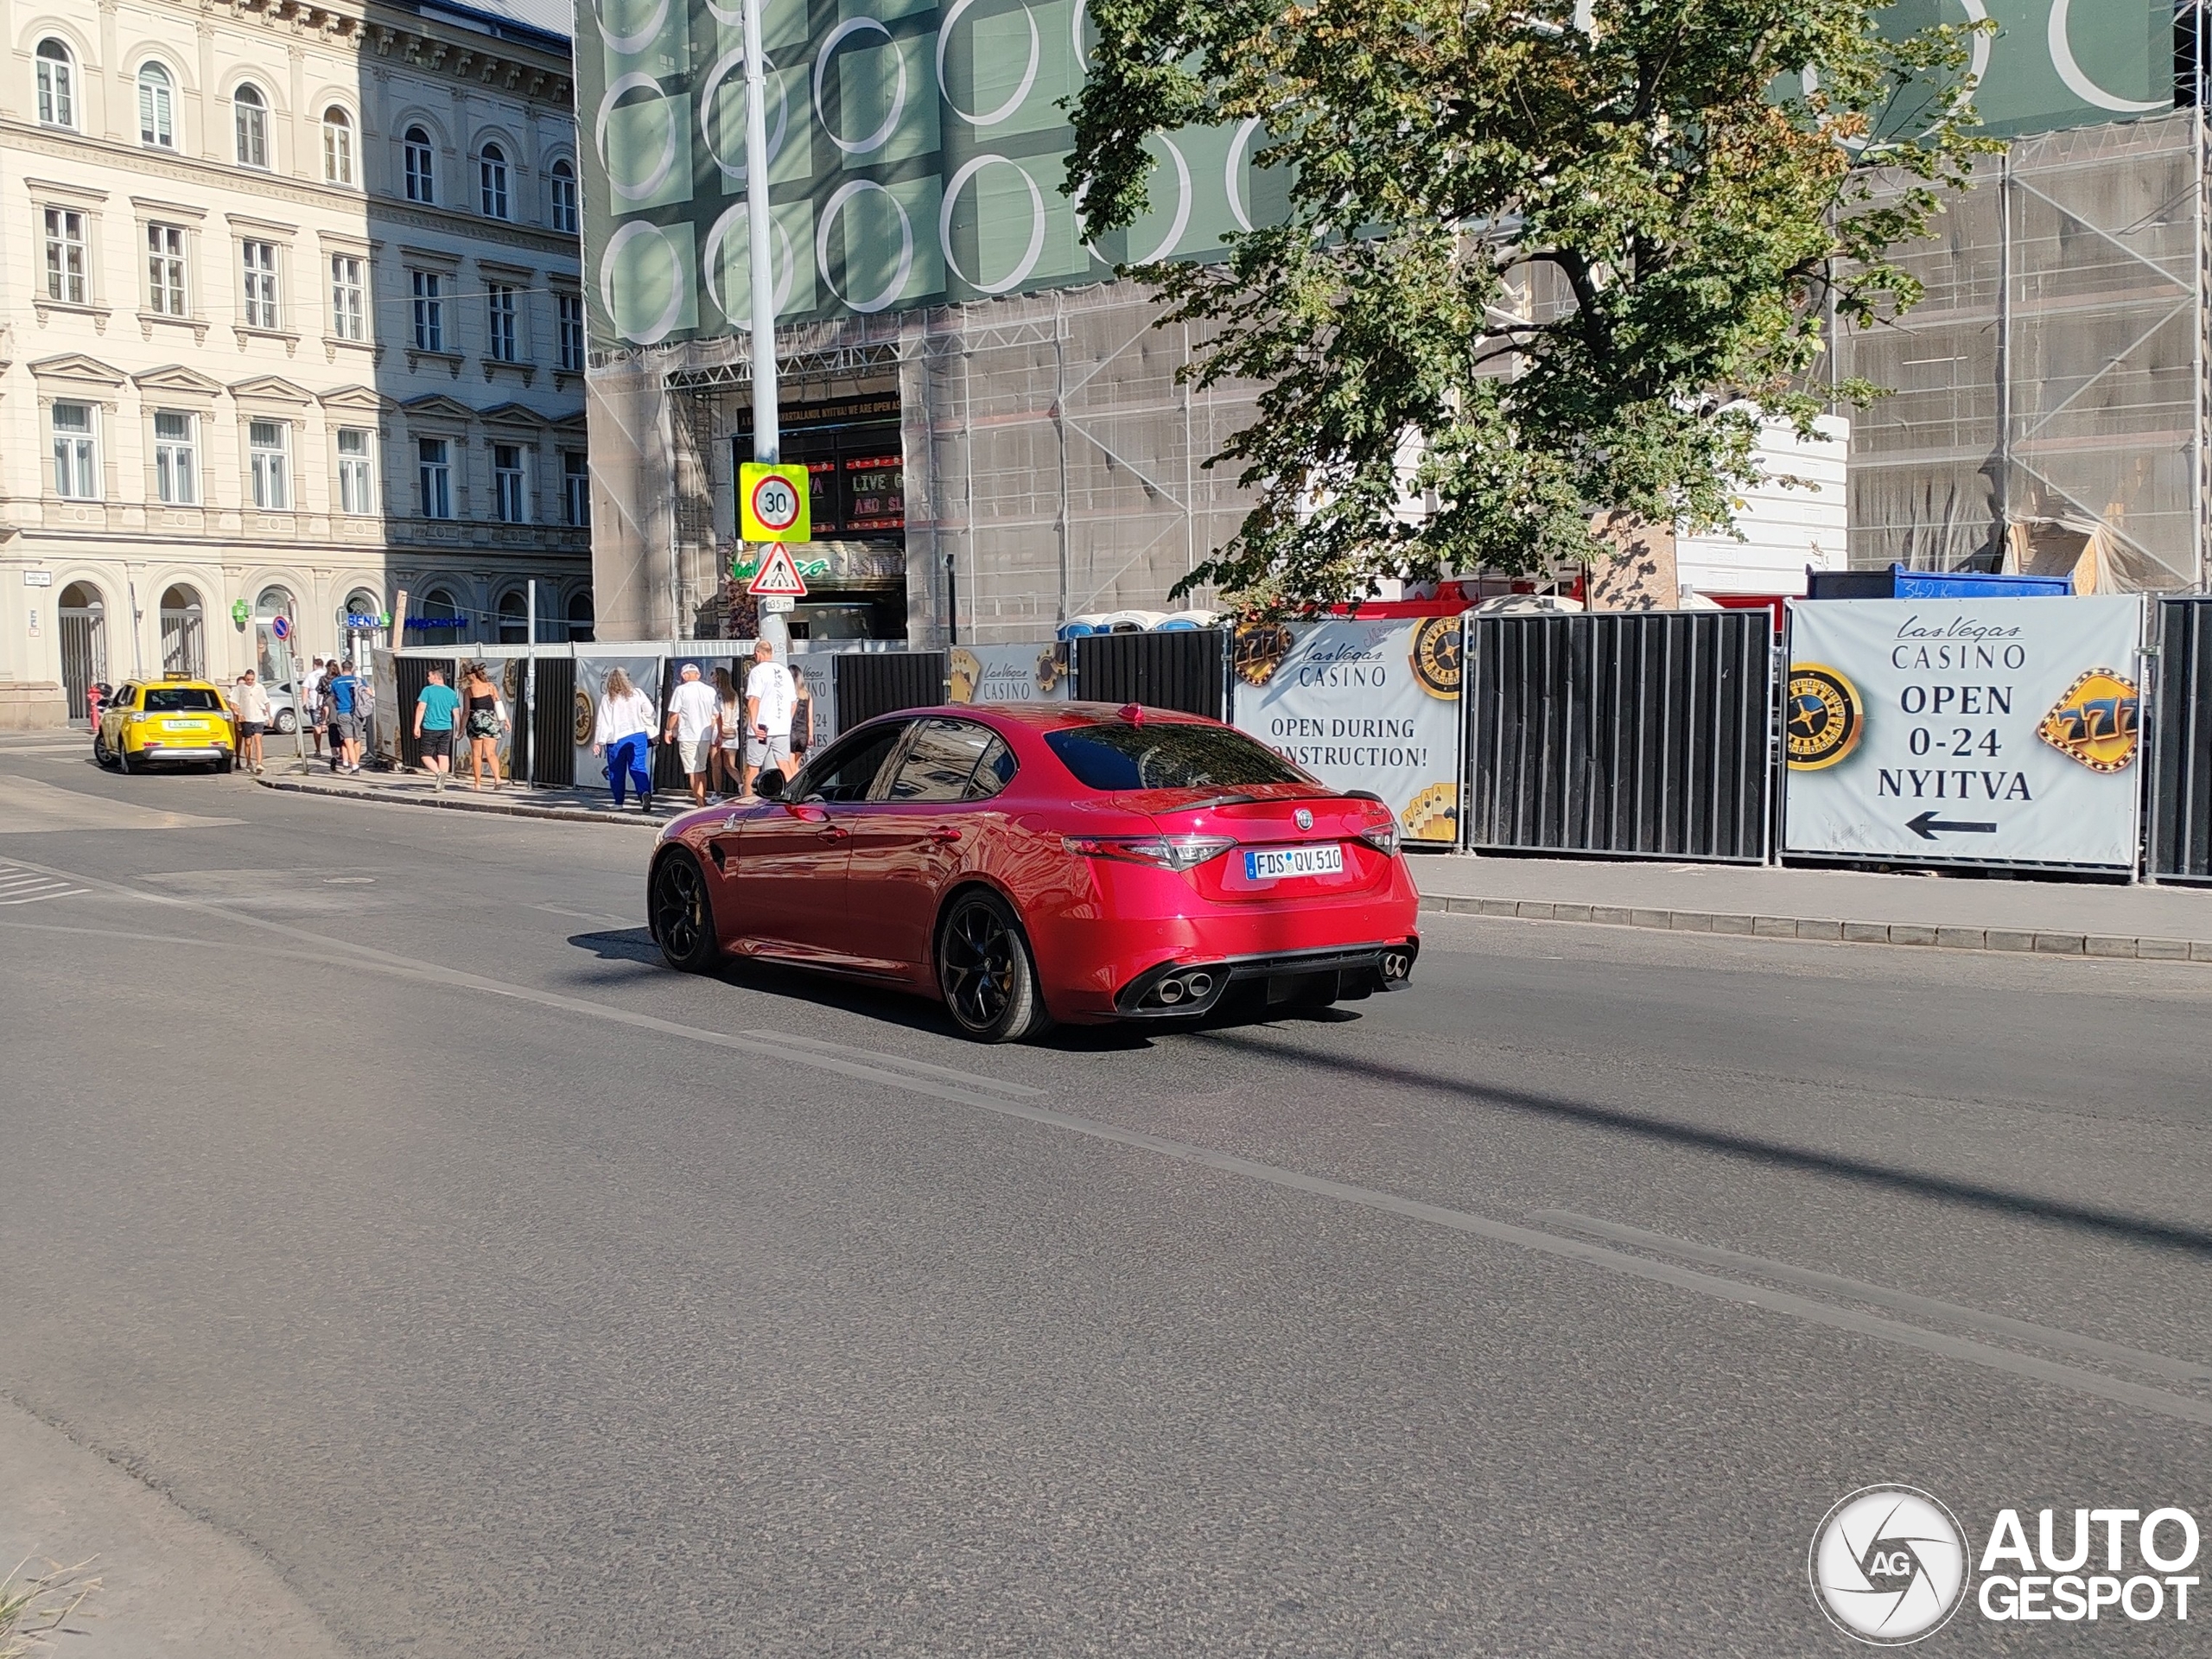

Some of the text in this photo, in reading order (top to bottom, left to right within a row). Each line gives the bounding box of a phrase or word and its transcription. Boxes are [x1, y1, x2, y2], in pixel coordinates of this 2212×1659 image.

[874, 401, 890, 412] OPEN
[853, 474, 886, 491] LIVE
[765, 492, 786, 513] 30
[347, 614, 380, 627] BENU
[1947, 615, 2022, 643] Vegas
[1335, 642, 1383, 665] Vegas
[1891, 644, 2025, 670] CASINO
[1300, 666, 1386, 687] CASINO
[983, 682, 1030, 701] CASINO
[1901, 685, 2013, 715] OPEN
[1271, 718, 1414, 738] OPEN DURING
[1910, 728, 2002, 757] 0-24
[1271, 746, 1427, 767] NSTRUCTION!
[1877, 768, 2033, 801] NYITVA
[1256, 854, 1285, 874] FDS
[1316, 849, 1340, 869] 510
